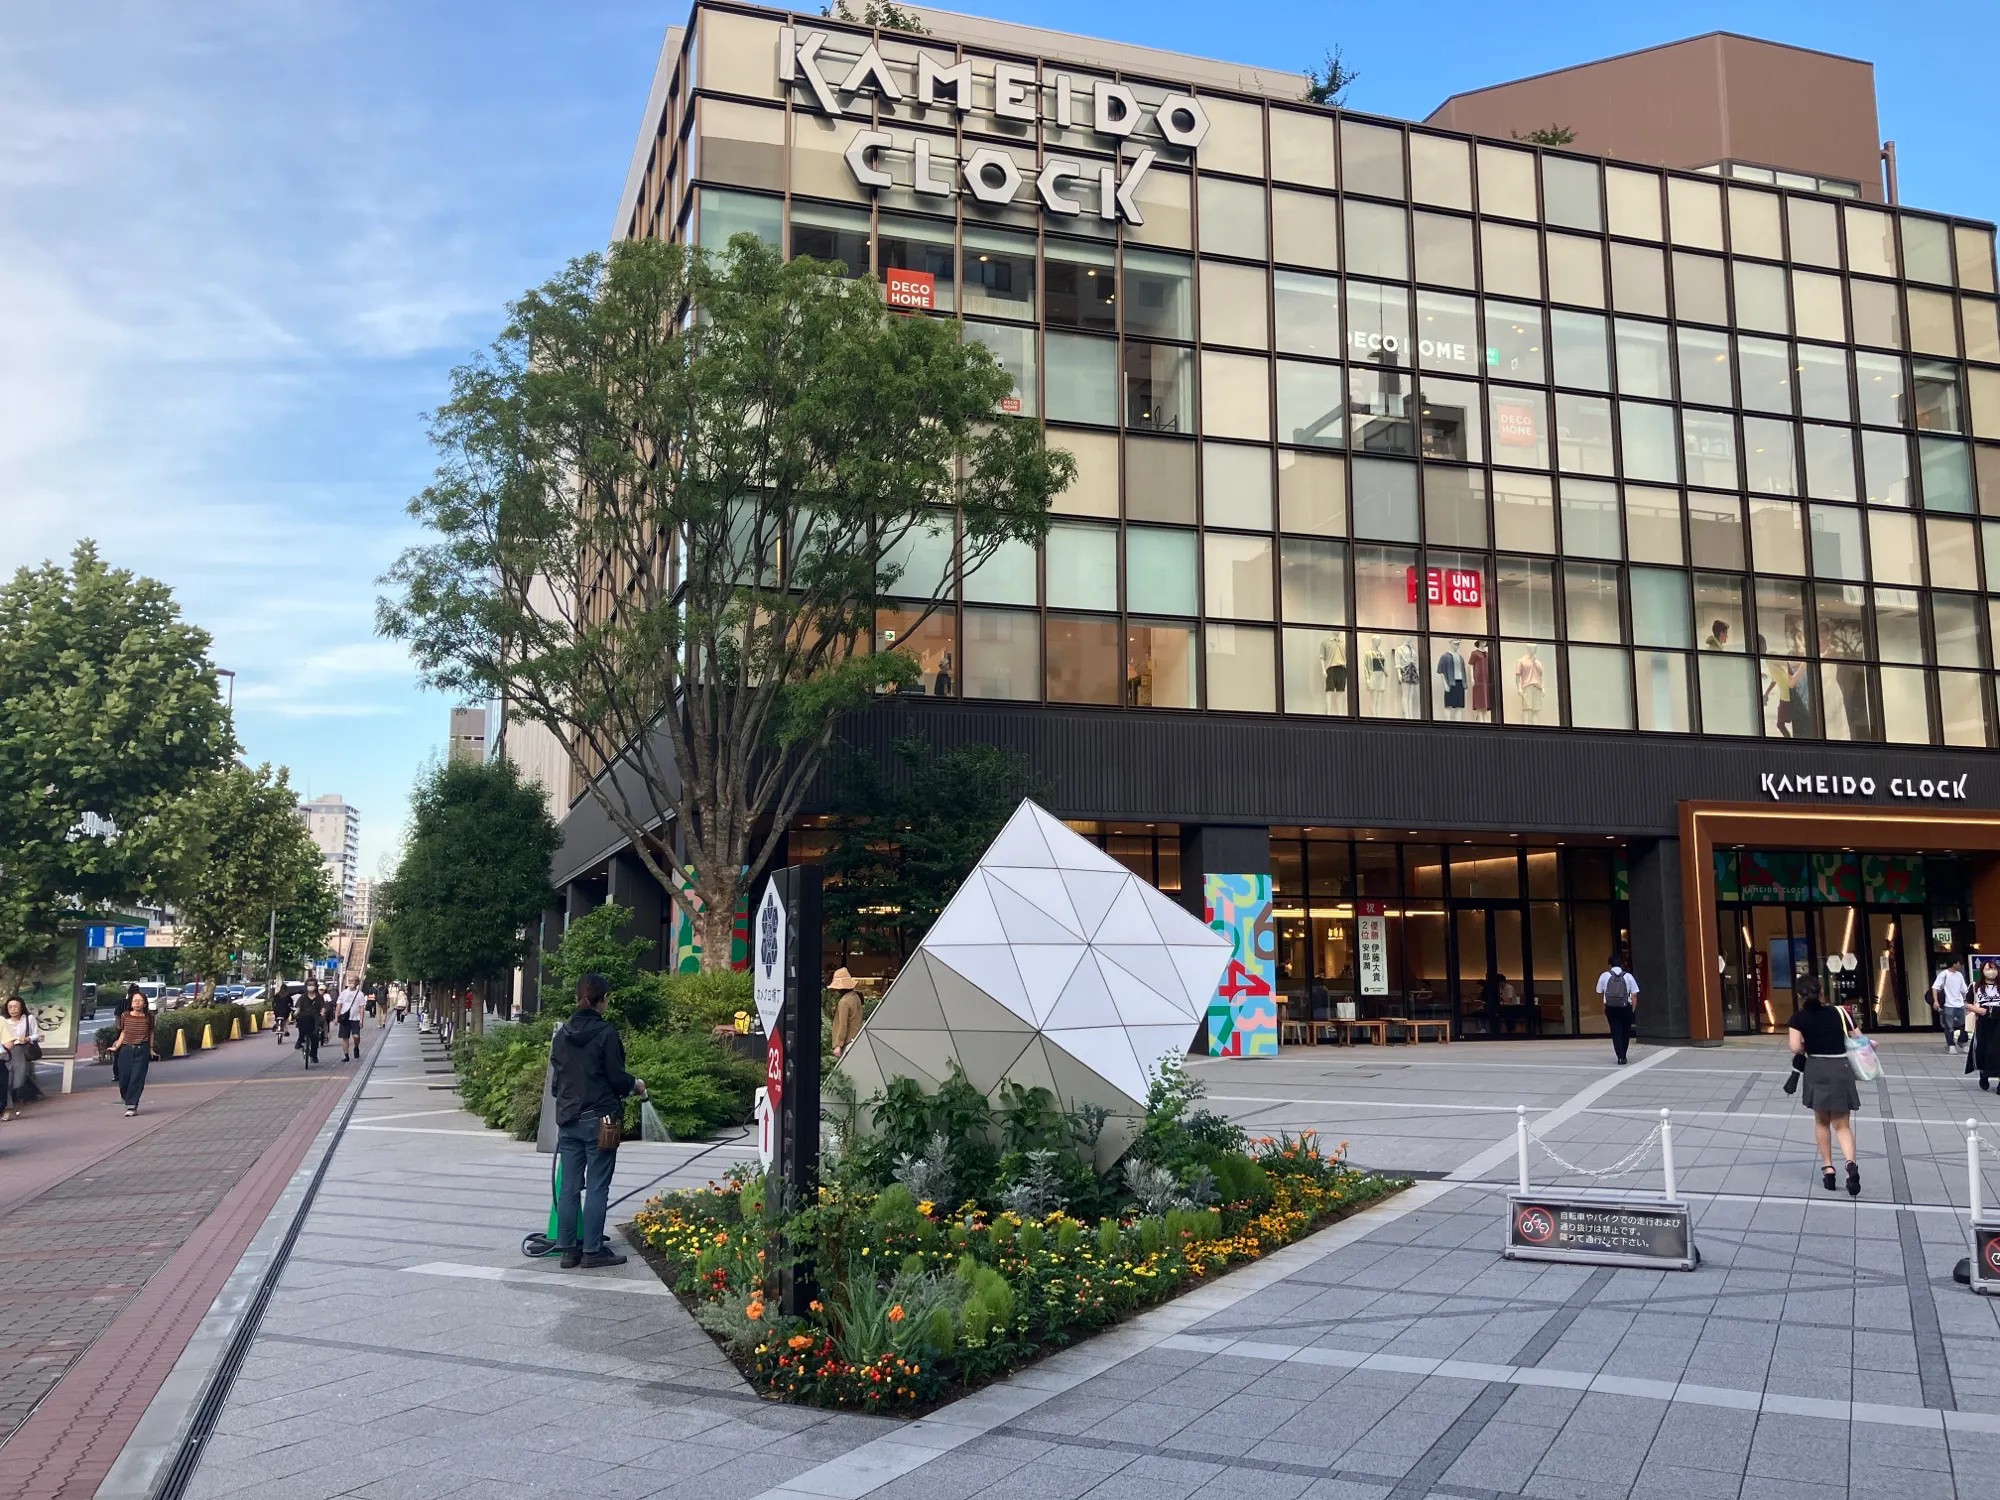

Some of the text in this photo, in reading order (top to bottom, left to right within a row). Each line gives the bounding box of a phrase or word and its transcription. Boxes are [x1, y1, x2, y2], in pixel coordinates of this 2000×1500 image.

[779, 26, 1210, 148] KAMEIDO
[844, 130, 1157, 226] CLOCK
[891, 280, 930, 295] DECO
[891, 292, 930, 307] HOME
[1501, 413, 1532, 427] DECO
[1502, 424, 1533, 437] HOME
[1452, 574, 1475, 588] UNI
[1453, 589, 1478, 603] QLO
[1761, 772, 1967, 800] KAMEIDO CLOCK
[1742, 886, 1778, 895] KAMEIDO
[1366, 903, 1375, 913] 祝
[1560, 1211, 1681, 1228] 自転車やバイクでの走行および
